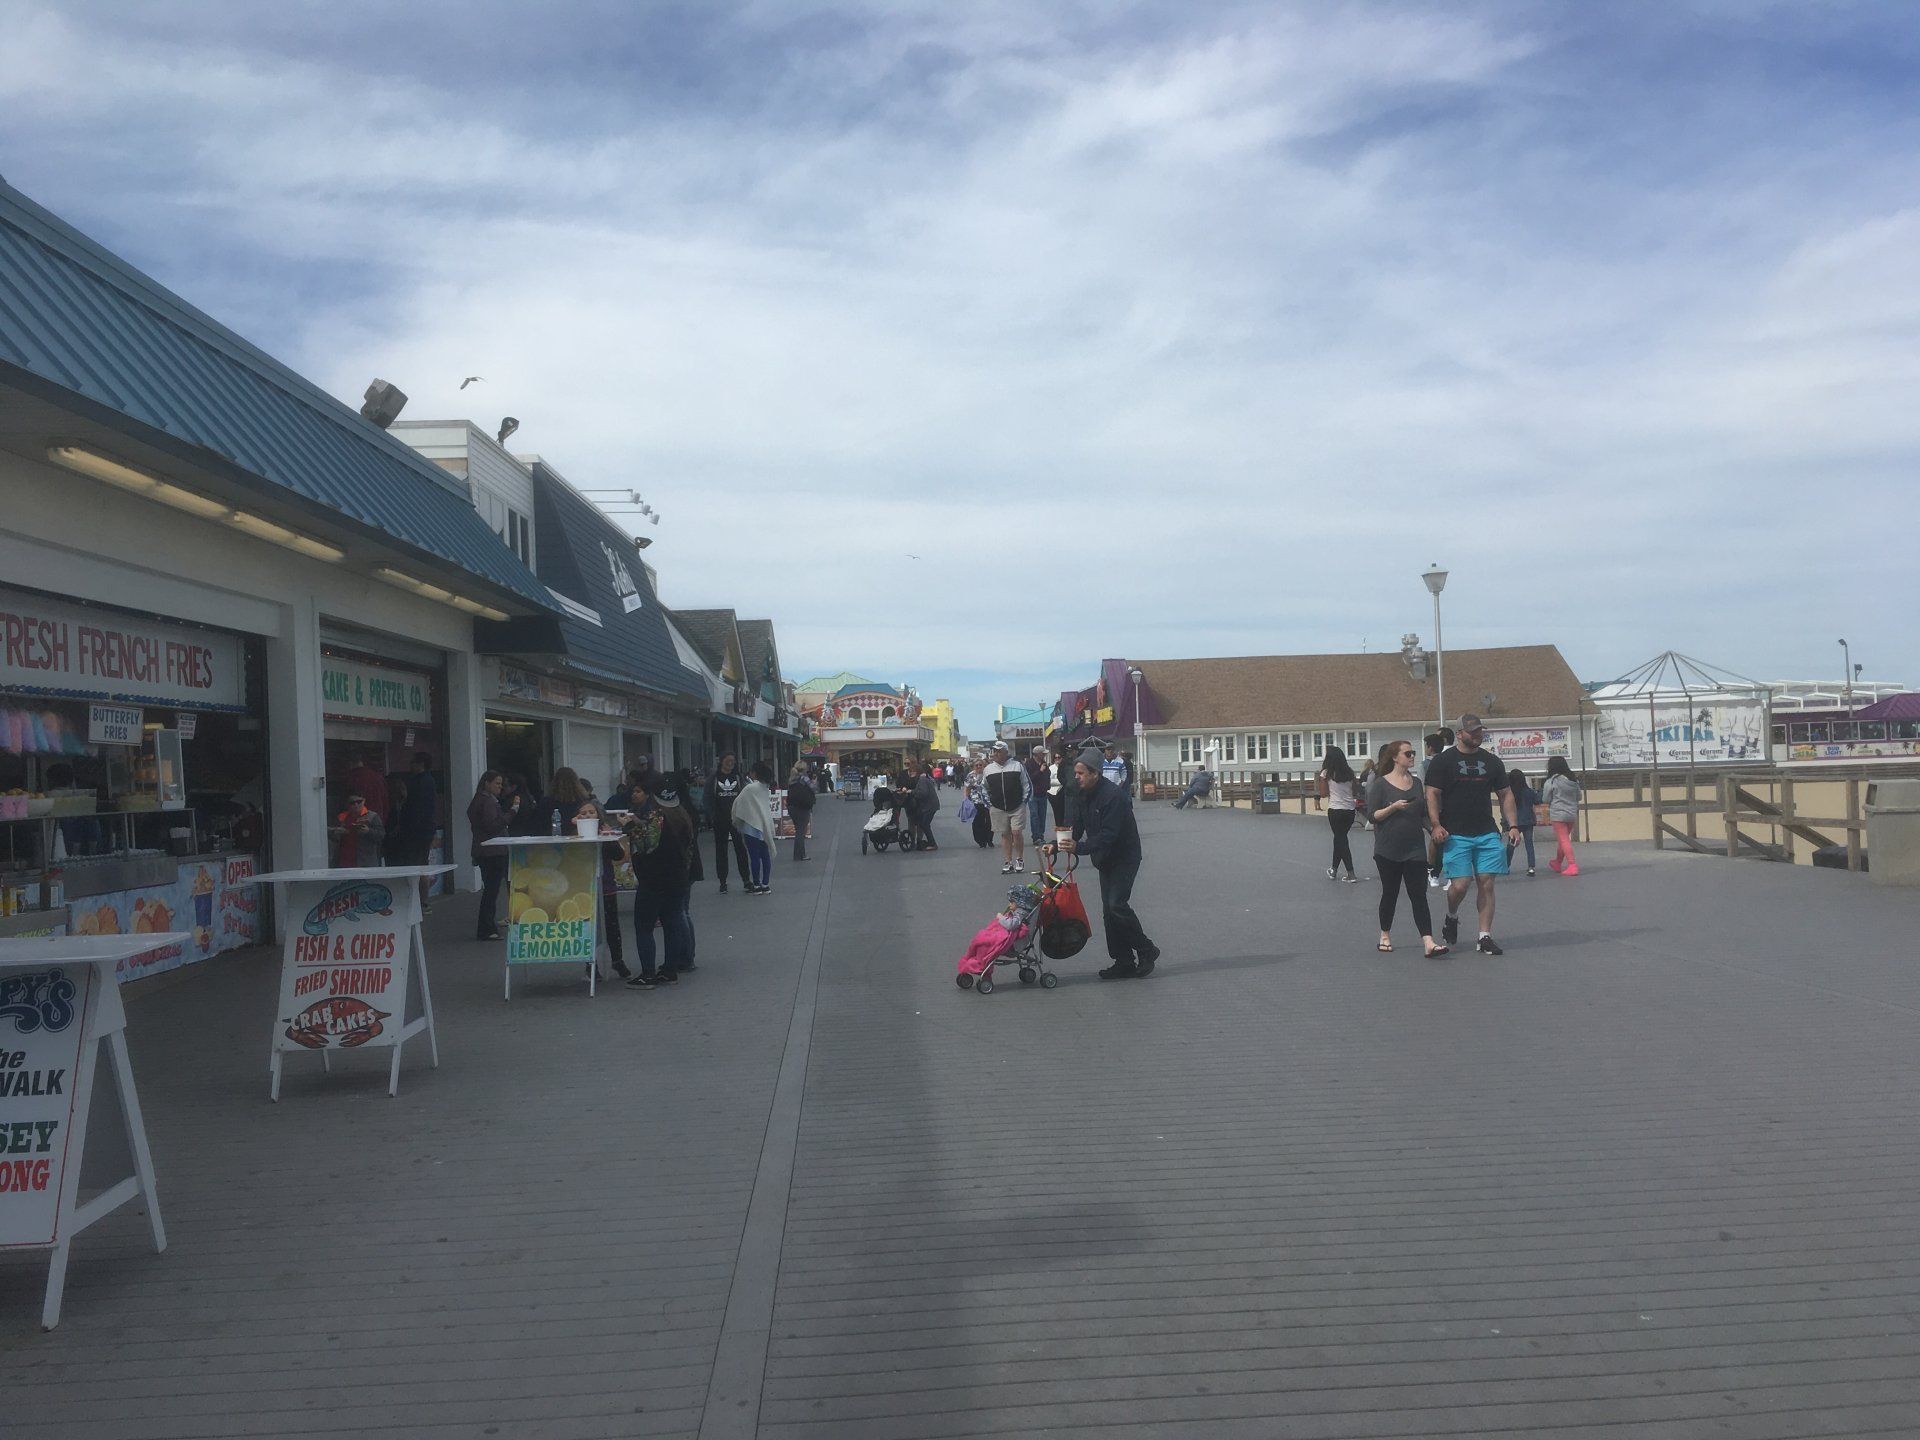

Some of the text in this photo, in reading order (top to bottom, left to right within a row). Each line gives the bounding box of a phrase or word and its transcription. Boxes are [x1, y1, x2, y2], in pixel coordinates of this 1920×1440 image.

[78, 625, 160, 684] FRENCH
[165, 641, 214, 689] FRIES
[322, 670, 349, 703] CAKE
[355, 675, 363, 706] &
[369, 678, 407, 710] PRETZEL
[92, 708, 140, 726] BUTTERFLY
[103, 724, 128, 741] FRIES
[228, 859, 253, 885] OPEN
[316, 892, 361, 921] FRESH
[519, 920, 584, 941] FRESH
[295, 932, 395, 962] FISH & CHIPS
[510, 939, 592, 959] LEMONADE
[294, 967, 392, 997] FRIED SHRIMP
[291, 1007, 332, 1031] CRAB
[326, 1008, 376, 1034] CAKES
